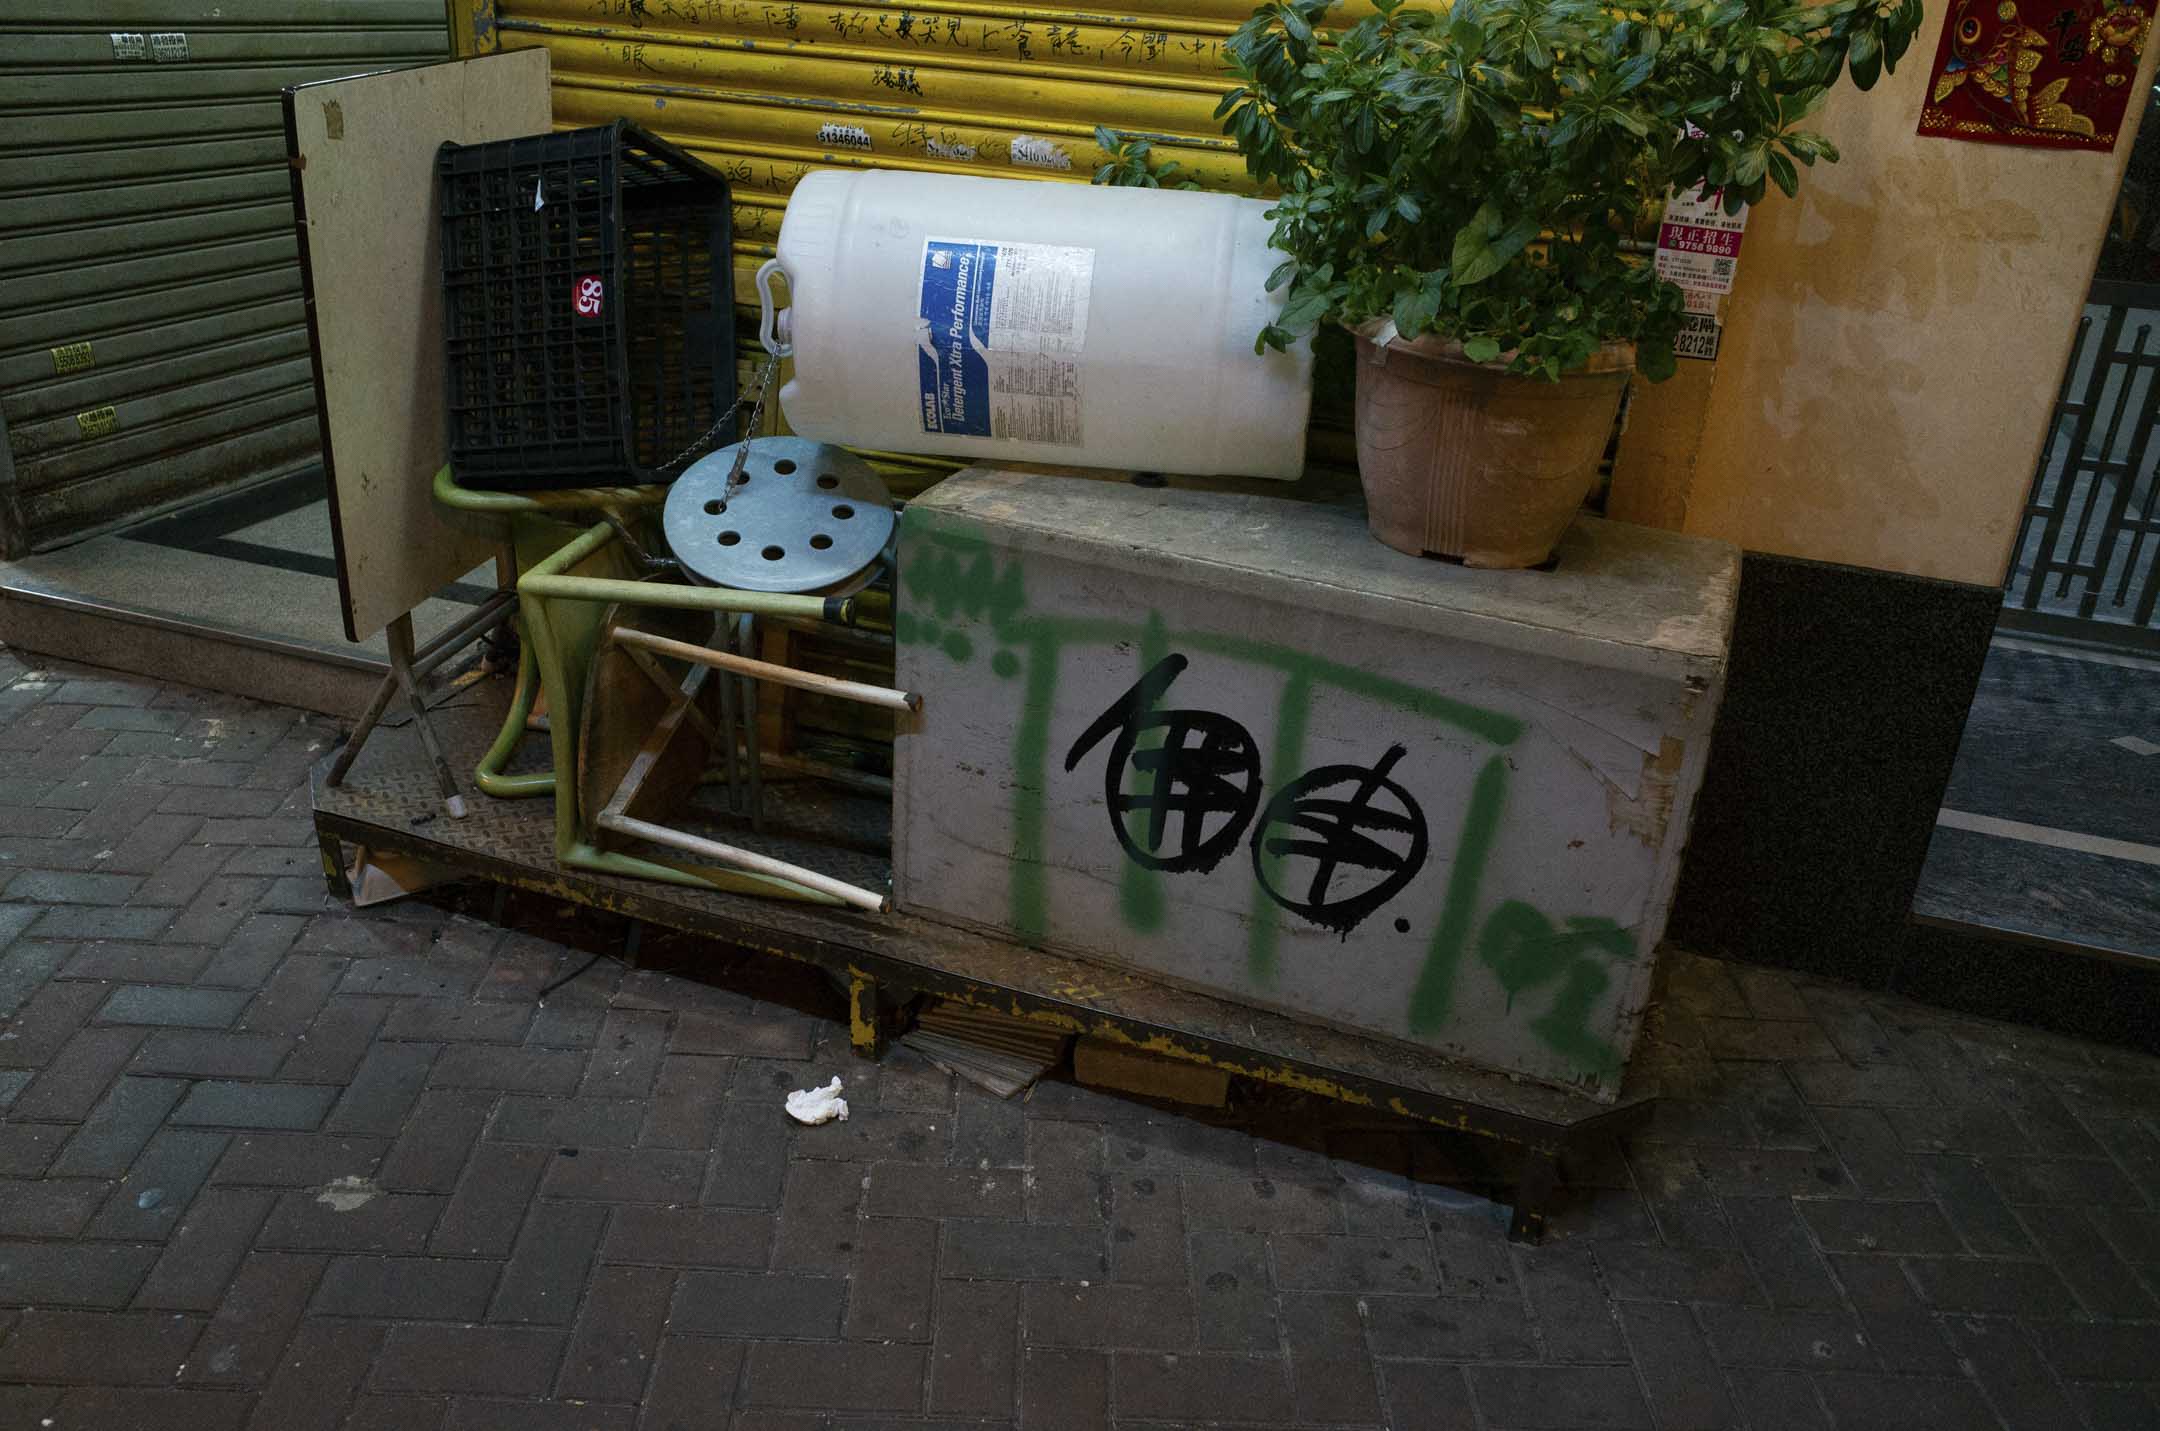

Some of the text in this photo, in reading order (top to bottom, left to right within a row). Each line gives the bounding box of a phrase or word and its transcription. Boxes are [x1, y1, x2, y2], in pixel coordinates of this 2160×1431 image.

[1668, 225, 1735, 247] 現正招生
[578, 278, 603, 314] 85
[949, 256, 970, 422] Detergent Xtra Performance
[924, 392, 938, 430] ECOLAB
